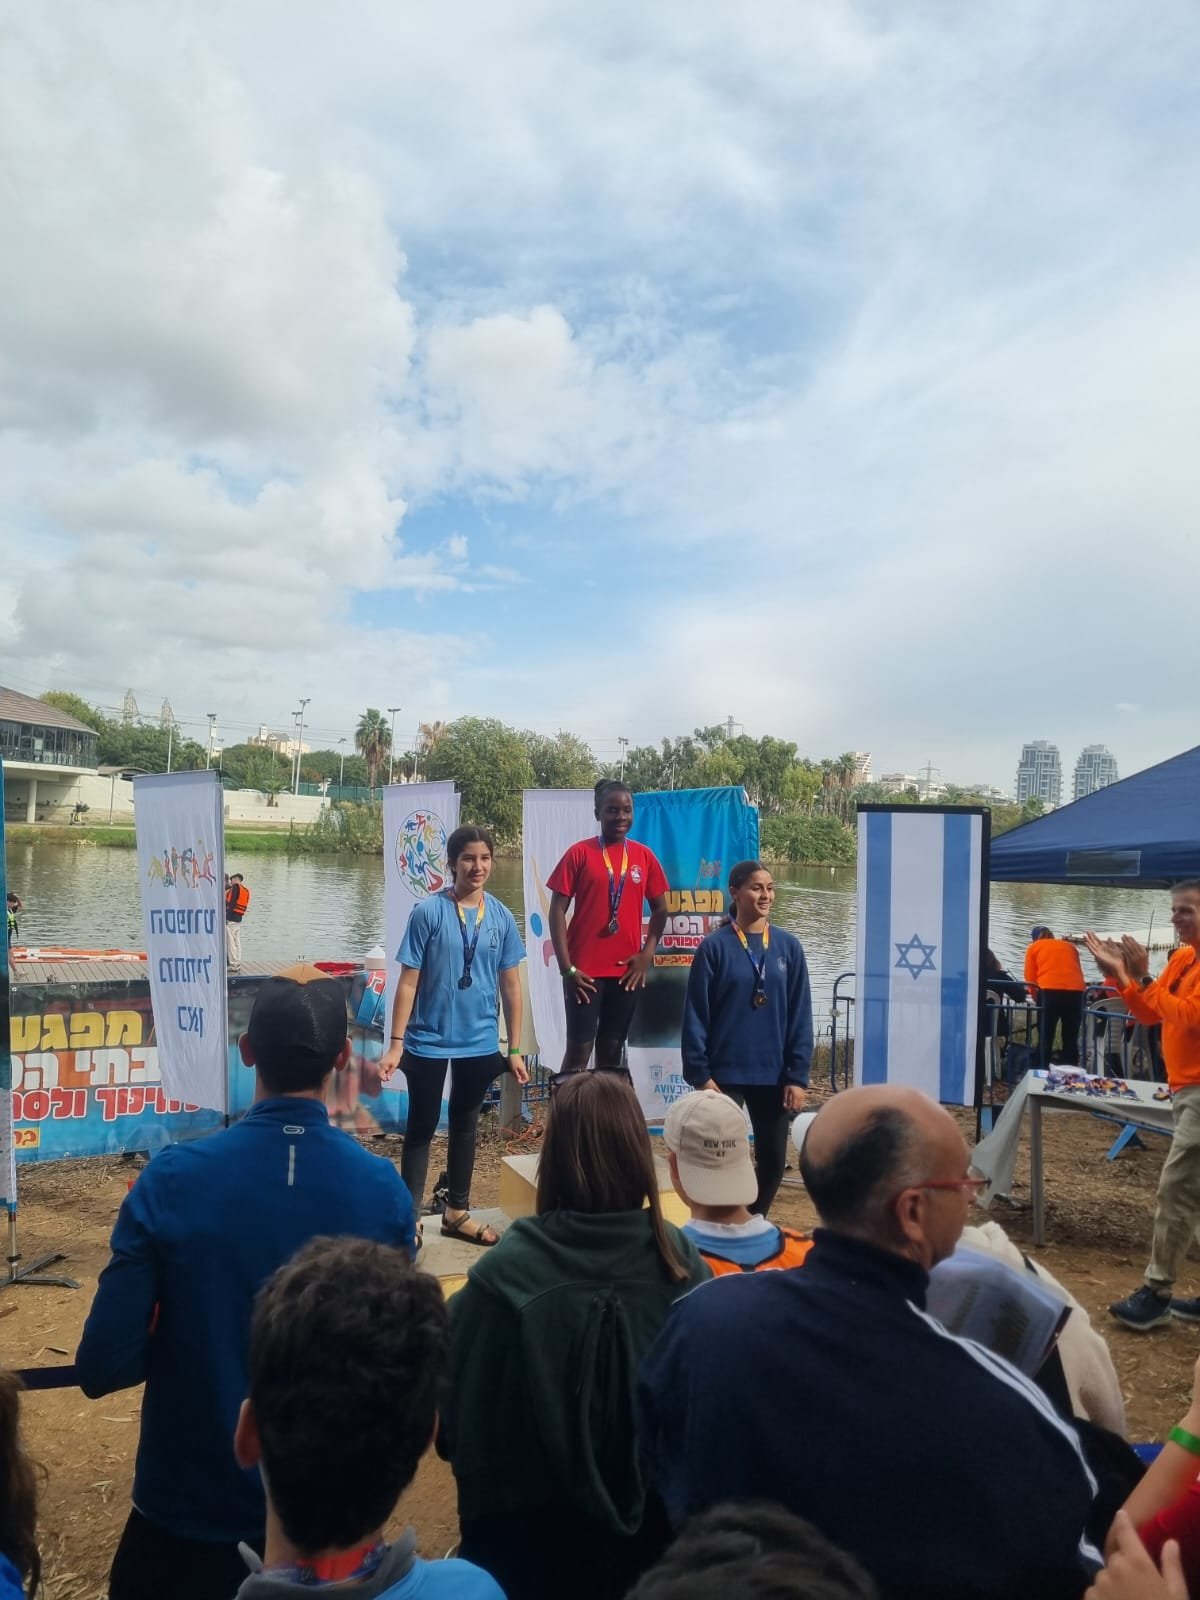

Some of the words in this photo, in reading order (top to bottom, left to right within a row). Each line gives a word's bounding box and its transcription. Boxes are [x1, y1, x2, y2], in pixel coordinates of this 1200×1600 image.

[654, 1084, 676, 1094] AVIV
[703, 1139, 719, 1149] NEW
[721, 1139, 737, 1149] YORK
